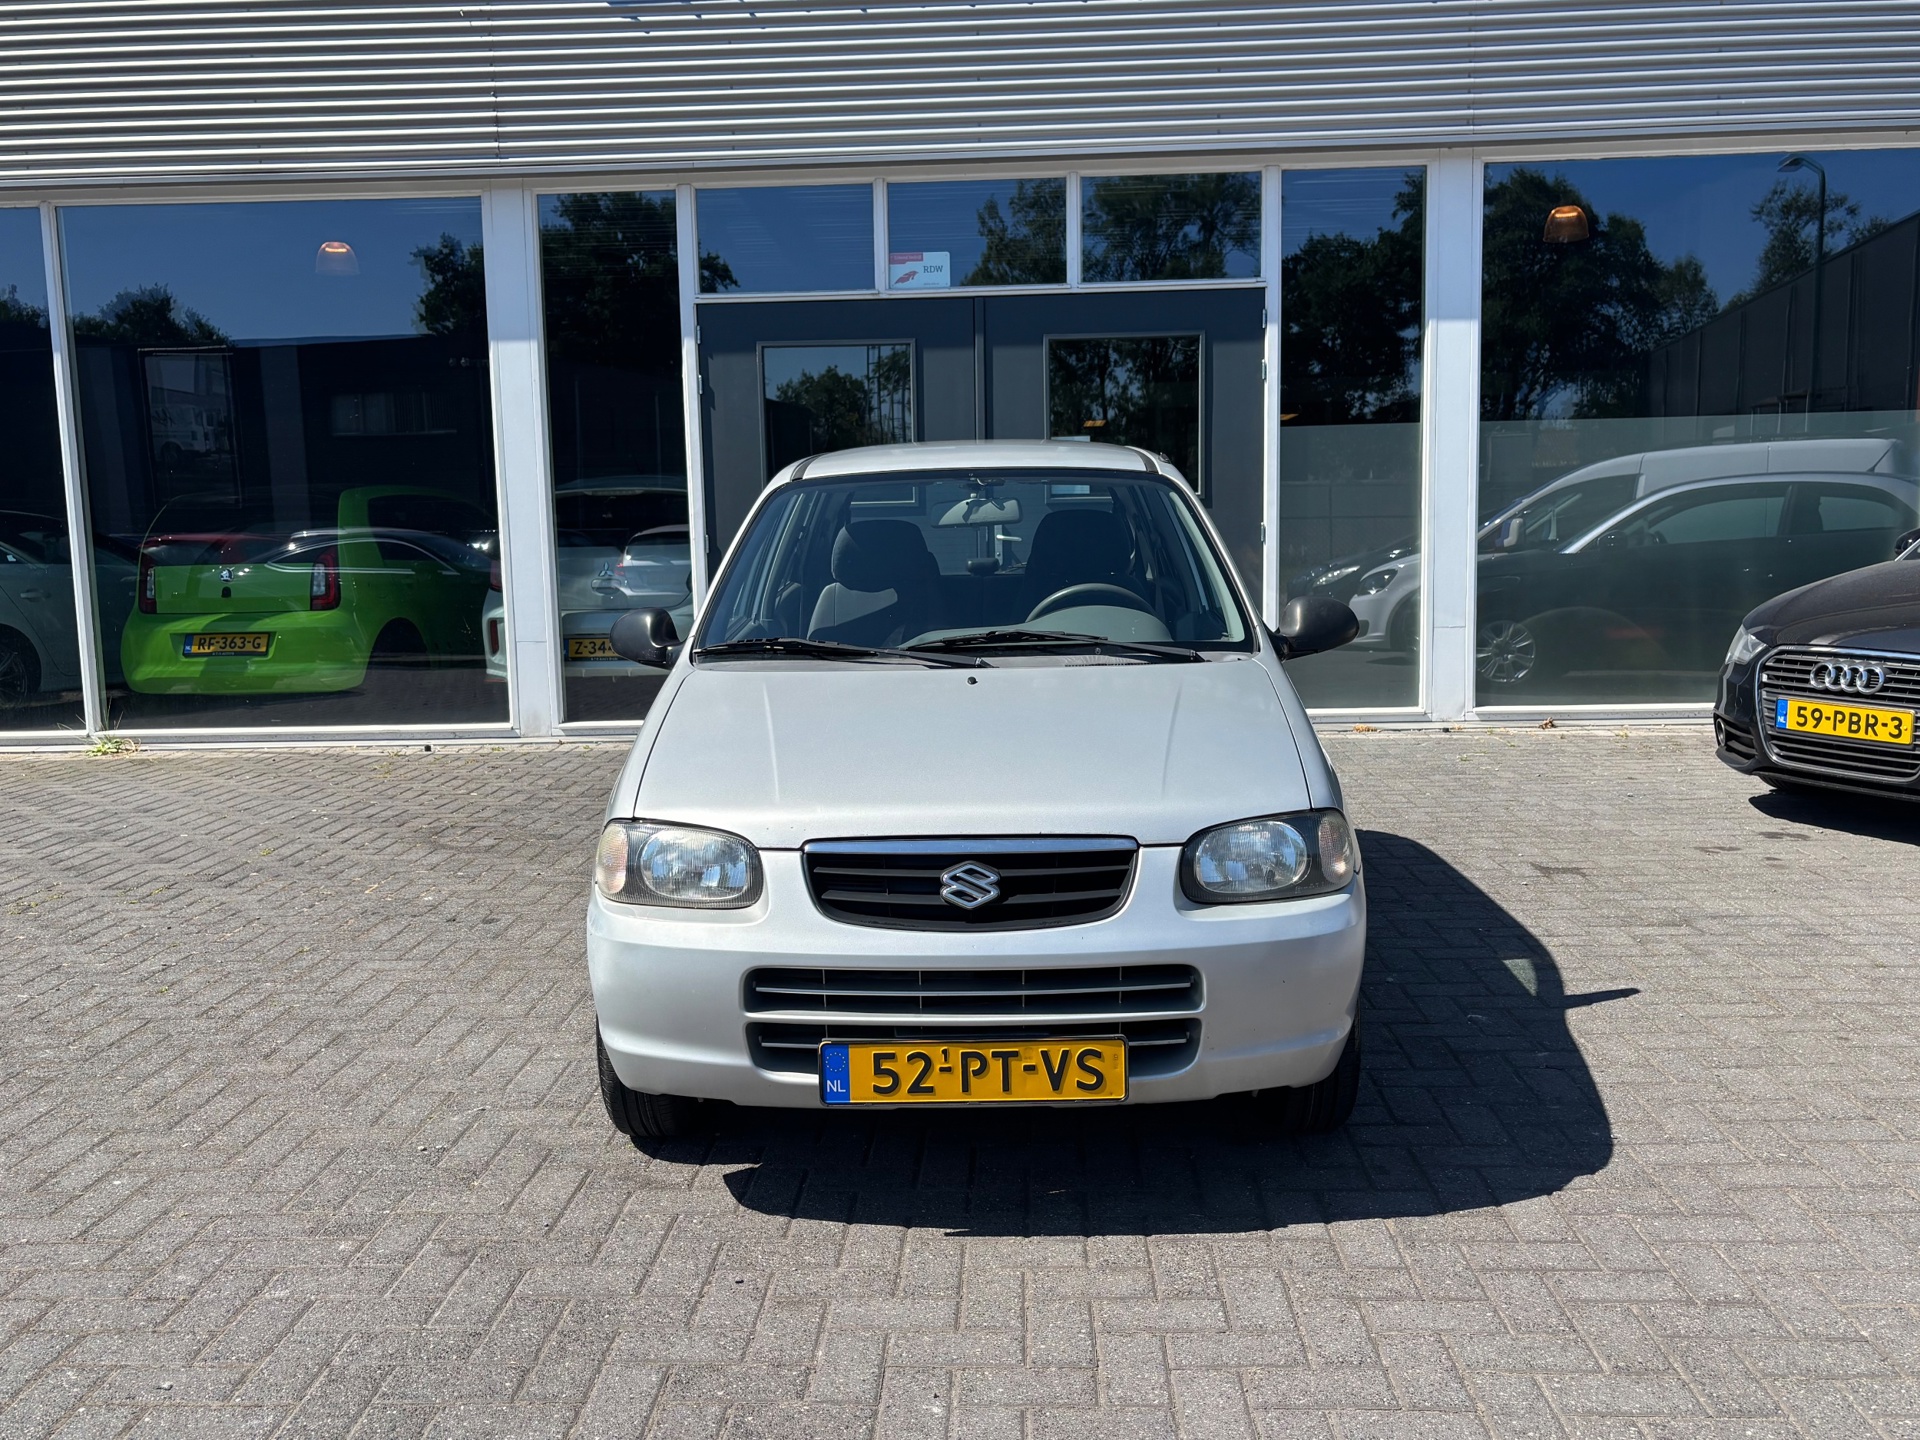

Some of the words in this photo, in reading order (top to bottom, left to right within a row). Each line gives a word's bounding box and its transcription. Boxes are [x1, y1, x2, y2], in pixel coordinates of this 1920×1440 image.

[923, 265, 943, 273] RDW
[197, 636, 261, 650] RF-363-G
[574, 641, 614, 655] Z-34
[1777, 715, 1786, 724] NL
[1796, 705, 1903, 739] 59-PBR-3
[826, 1079, 846, 1093] NL
